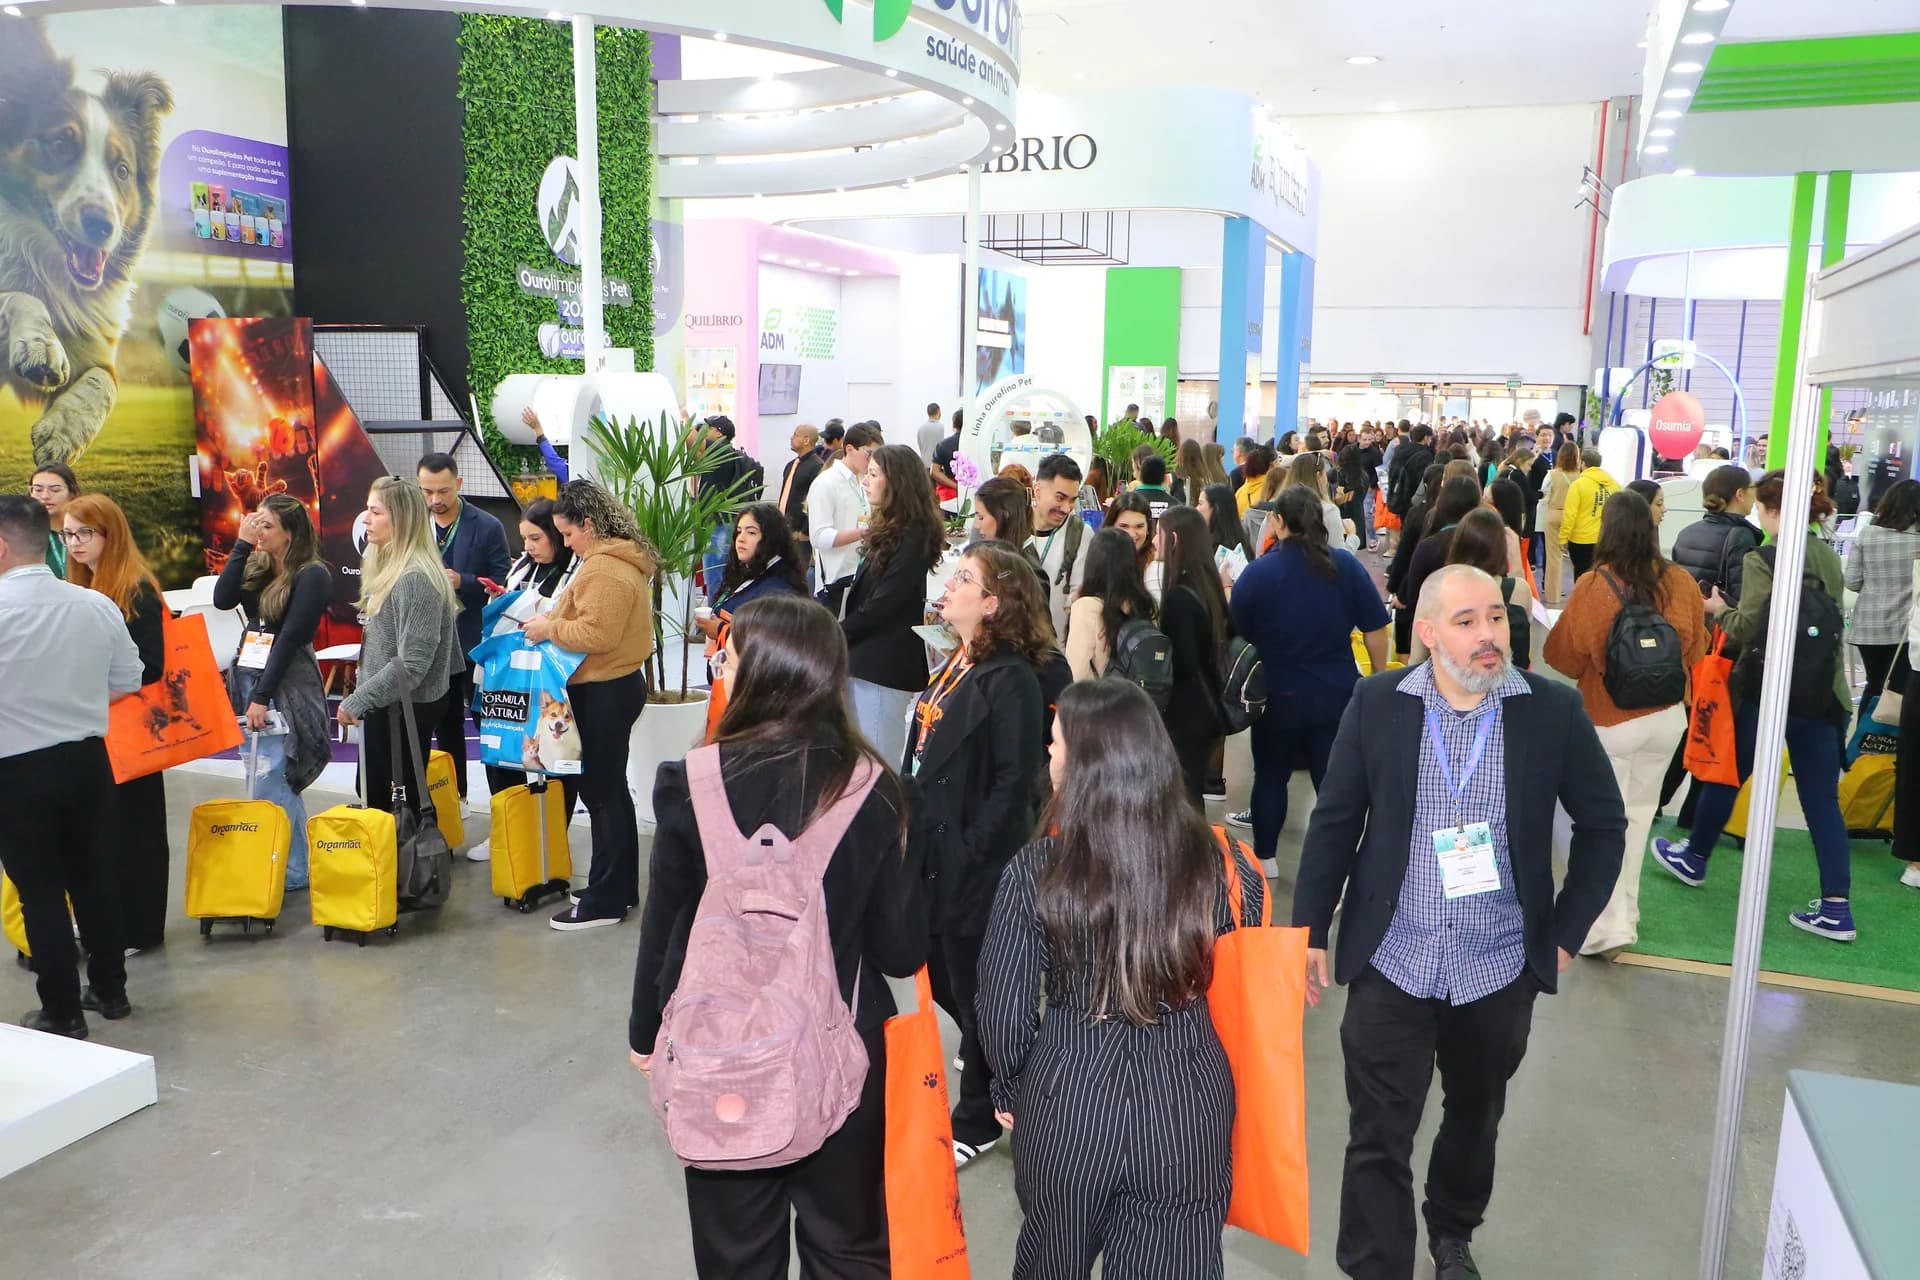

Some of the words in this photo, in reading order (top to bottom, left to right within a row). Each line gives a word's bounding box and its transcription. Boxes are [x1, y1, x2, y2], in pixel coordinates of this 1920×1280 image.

[926, 35, 976, 74] saúde
[978, 60, 1010, 97] anima
[232, 162, 246, 170] para
[246, 164, 261, 172] cada
[243, 154, 254, 162] Pet
[254, 156, 267, 165] todo
[267, 159, 278, 168] pet
[609, 281, 629, 297] Pet
[684, 314, 743, 330] QUILÍBRIO
[760, 333, 784, 350] ADM
[971, 411, 987, 437] Linha
[984, 382, 1017, 412] Ourofino
[1016, 377, 1032, 388] Pet
[1655, 420, 1692, 432] Osurnia
[341, 566, 362, 576] Ouro
[482, 693, 527, 706] FÓRMULA
[481, 707, 527, 721] NATURAL
[211, 822, 259, 836] Organnact
[317, 840, 361, 853] Organnact
